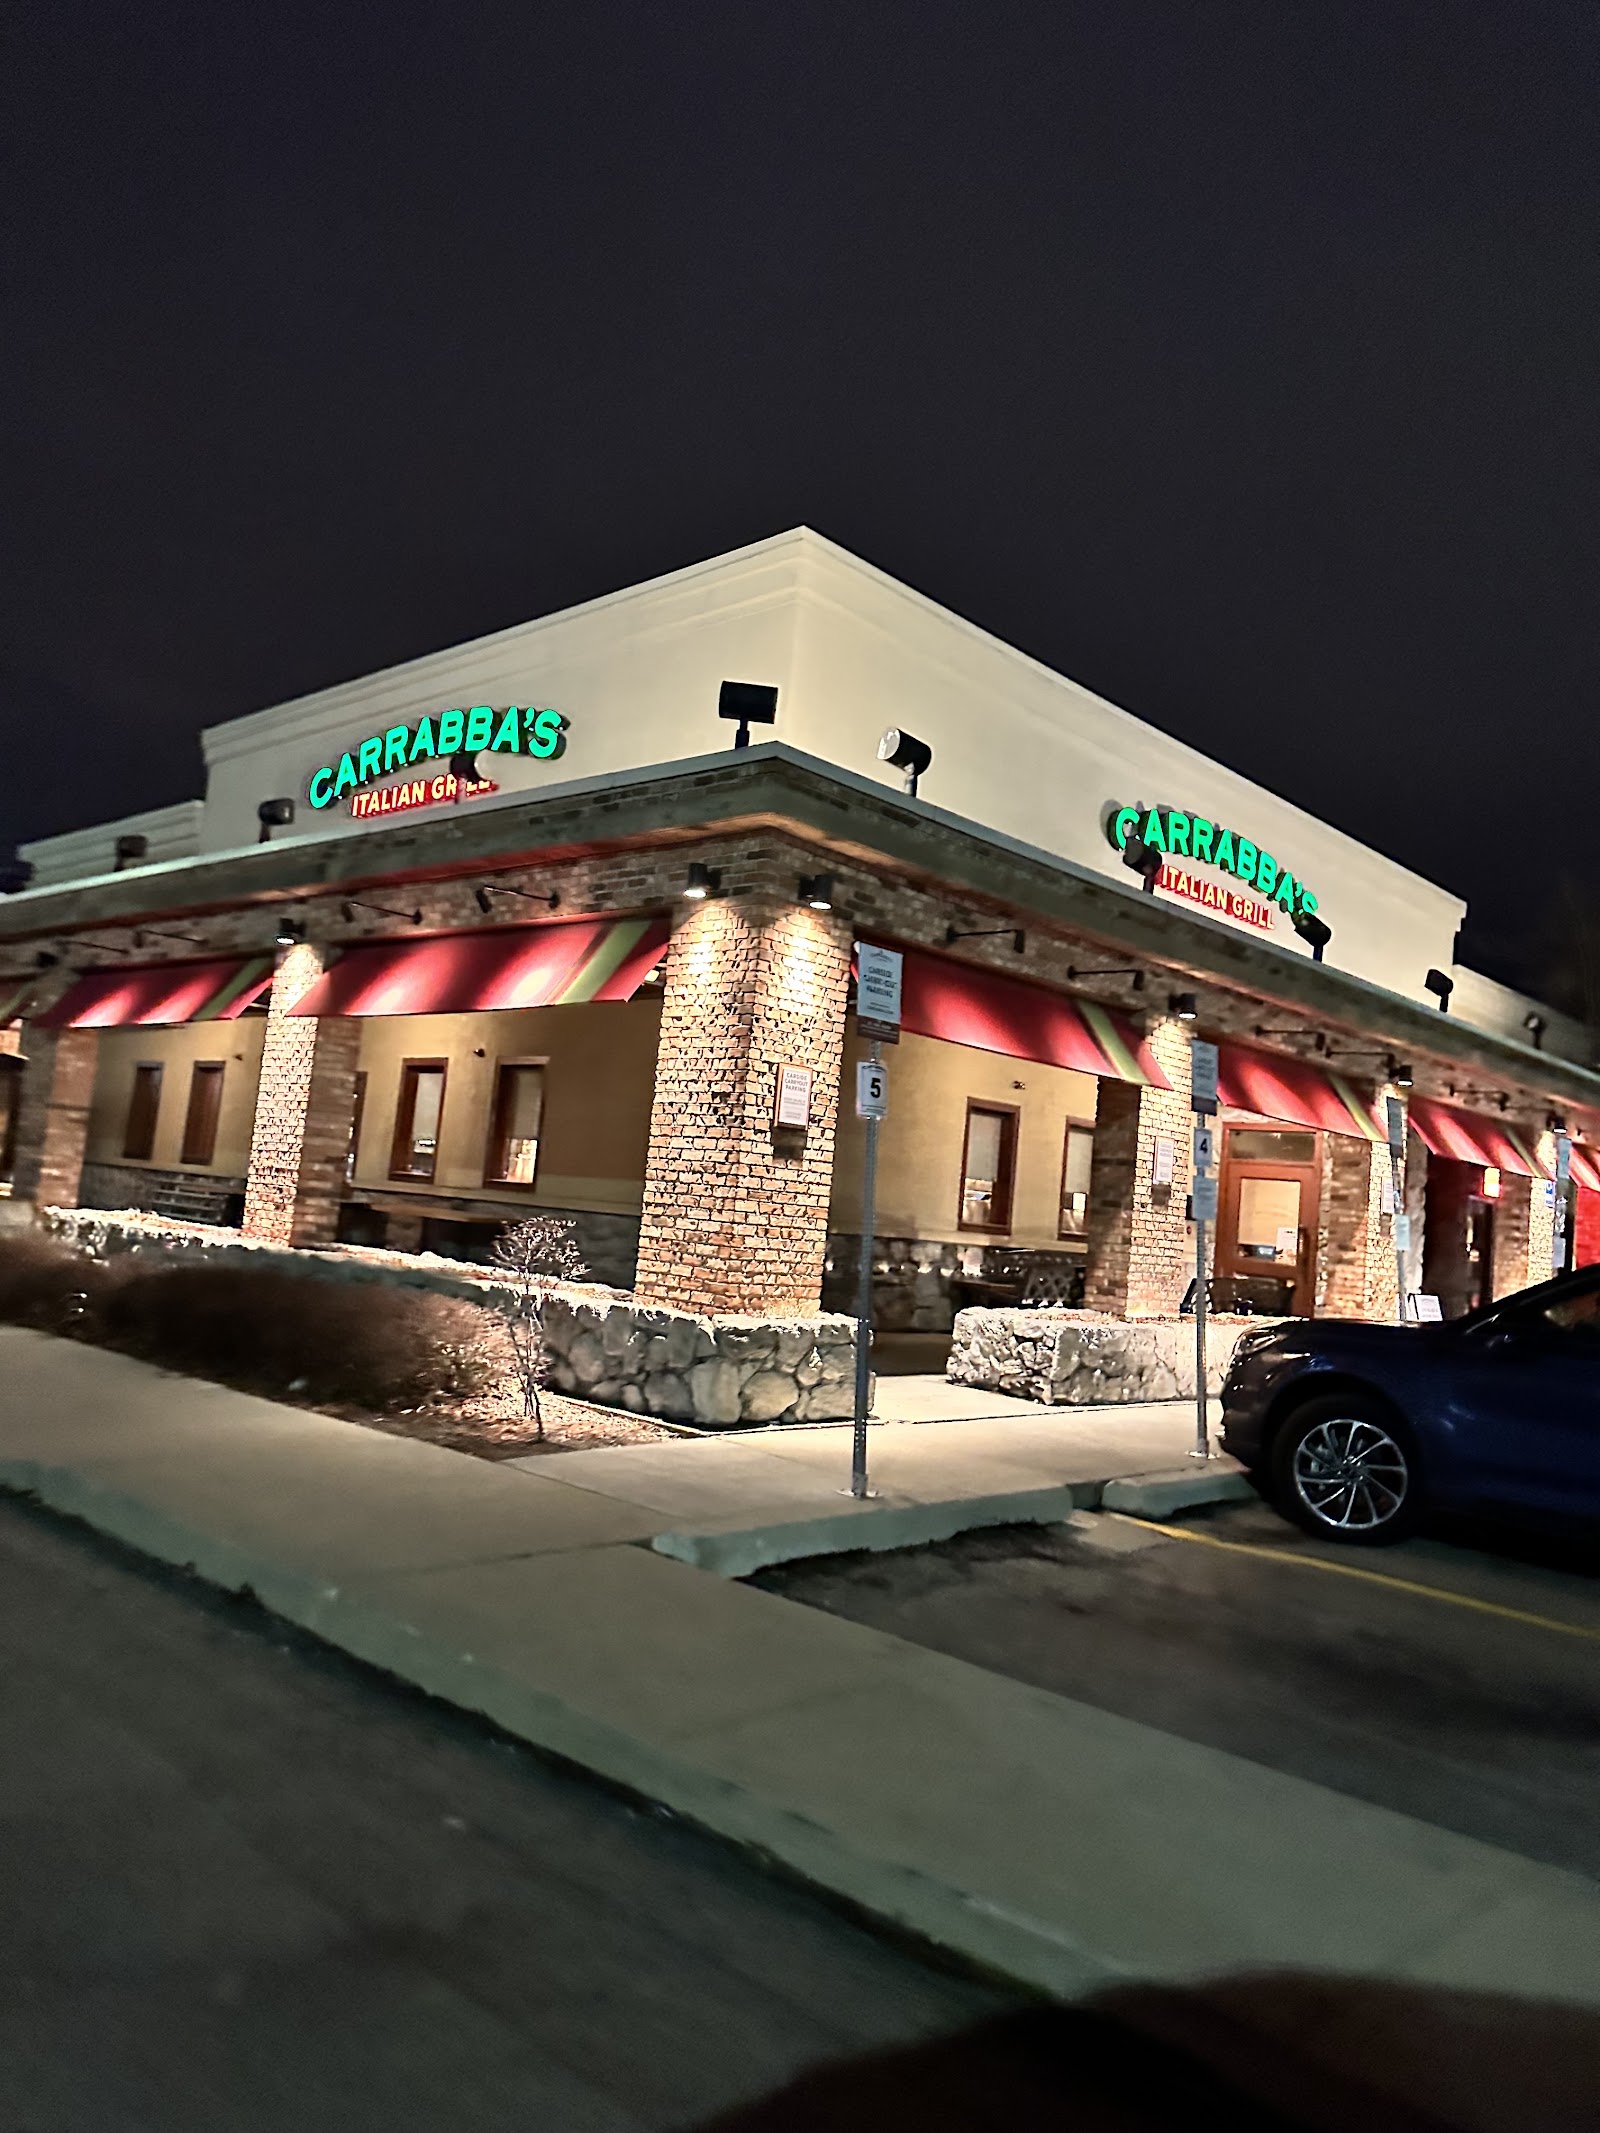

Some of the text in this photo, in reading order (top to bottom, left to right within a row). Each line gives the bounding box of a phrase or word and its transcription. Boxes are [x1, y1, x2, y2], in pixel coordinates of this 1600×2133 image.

[309, 706, 563, 809] CARRABBA'S
[352, 773, 491, 817] ITALIAN GRLL
[1115, 806, 1319, 916] CARRABBA'S
[1161, 863, 1275, 930] ITALIAN GRILL
[785, 1084, 806, 1093] PARKING
[870, 1077, 881, 1098] 5
[1200, 1137, 1208, 1154] 4
